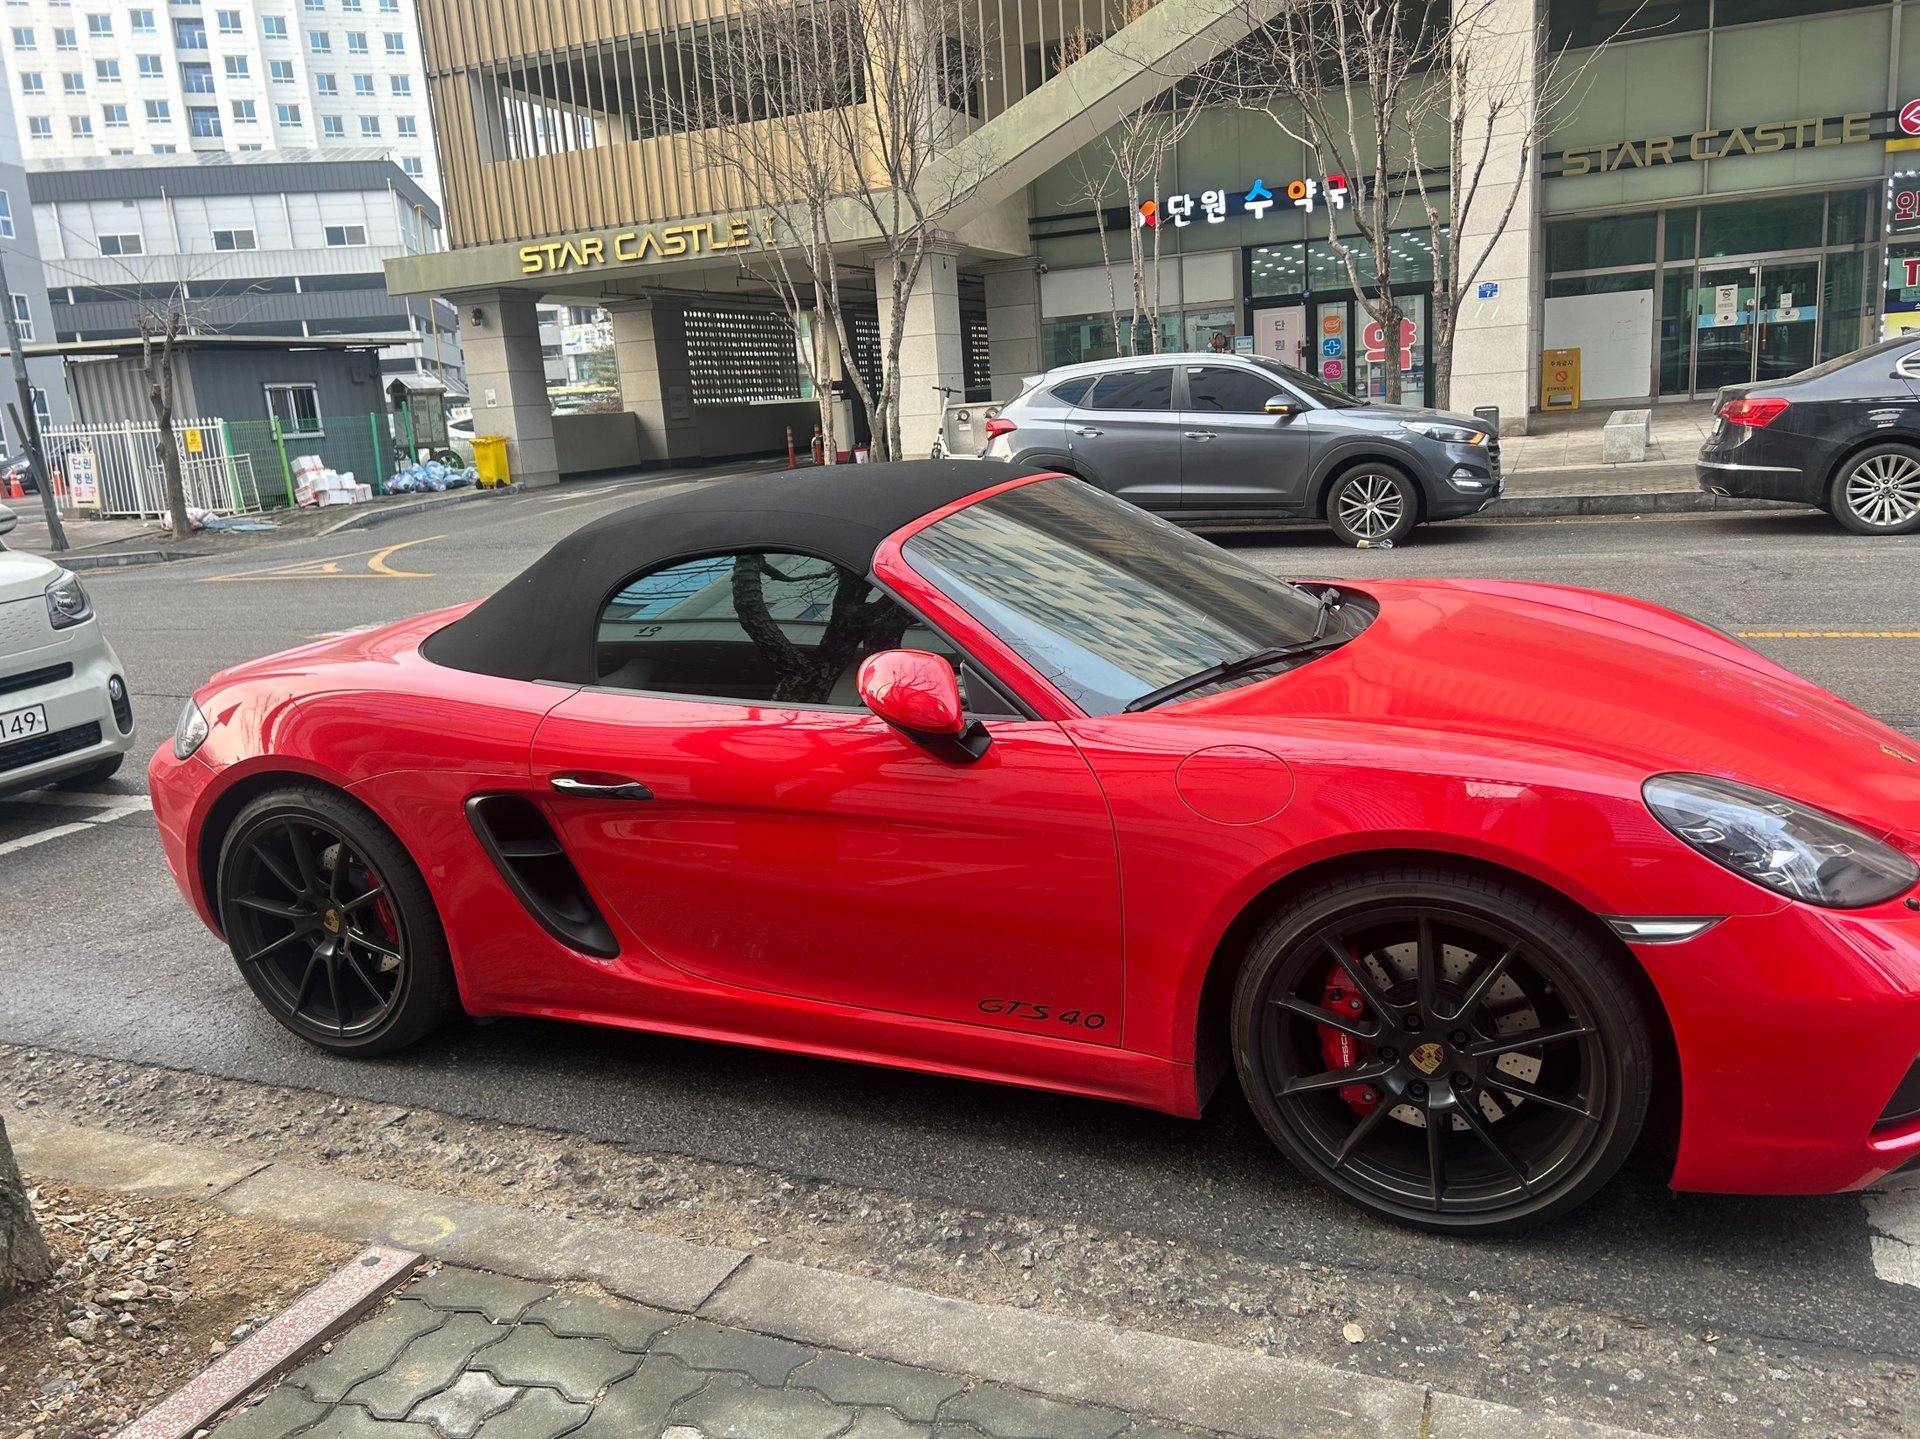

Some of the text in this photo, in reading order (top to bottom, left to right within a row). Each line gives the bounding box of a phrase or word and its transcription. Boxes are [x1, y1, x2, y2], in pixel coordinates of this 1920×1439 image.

[1562, 112, 1871, 177] STAR CASTLE
[1167, 189, 1226, 227] 단원
[1244, 178, 1274, 219] 수
[519, 237, 605, 273] STAR
[614, 219, 750, 261] CASTLE
[977, 998, 1106, 1030] GTS 4.0
